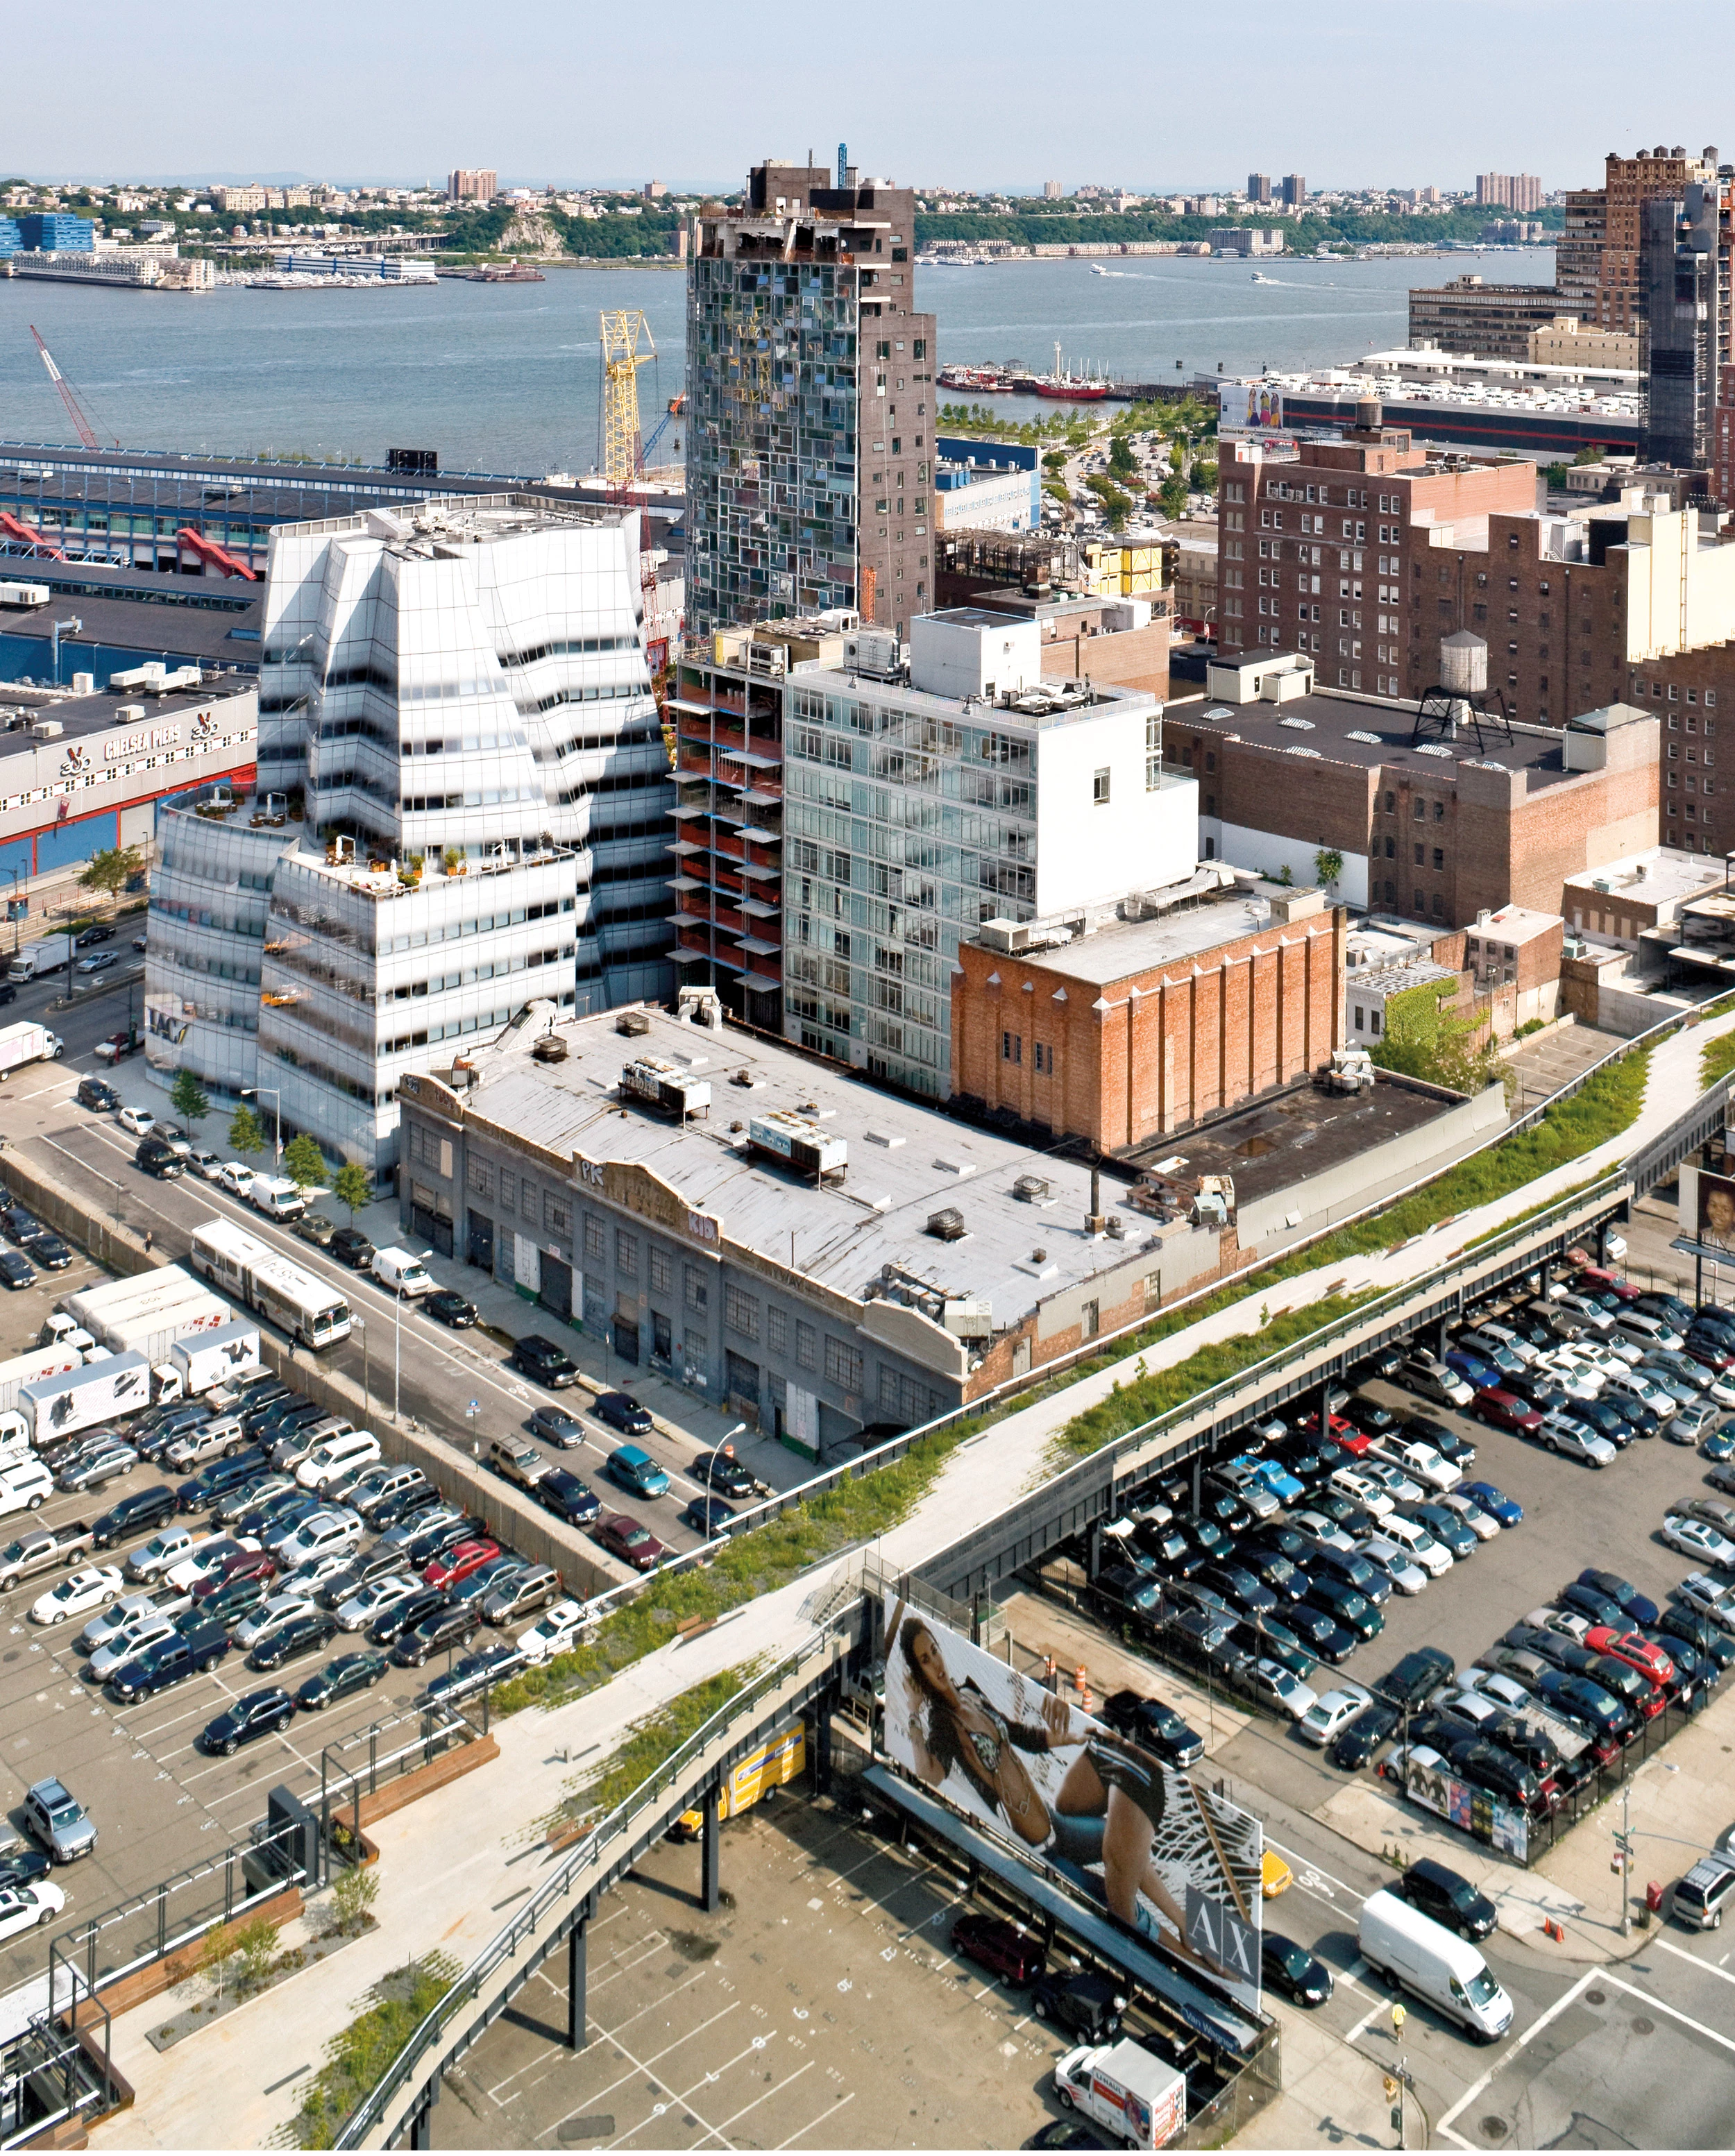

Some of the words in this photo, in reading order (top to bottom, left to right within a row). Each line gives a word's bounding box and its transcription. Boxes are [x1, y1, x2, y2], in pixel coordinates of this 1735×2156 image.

[105, 733, 149, 761] CHELSEA
[151, 724, 181, 749] PIERS
[836, 1978, 852, 1992] 10
[793, 2006, 809, 2020] 9
[1185, 2008, 1201, 2028] Van
[1202, 2021, 1235, 2051] Wagner
[752, 2036, 765, 2048] 8
